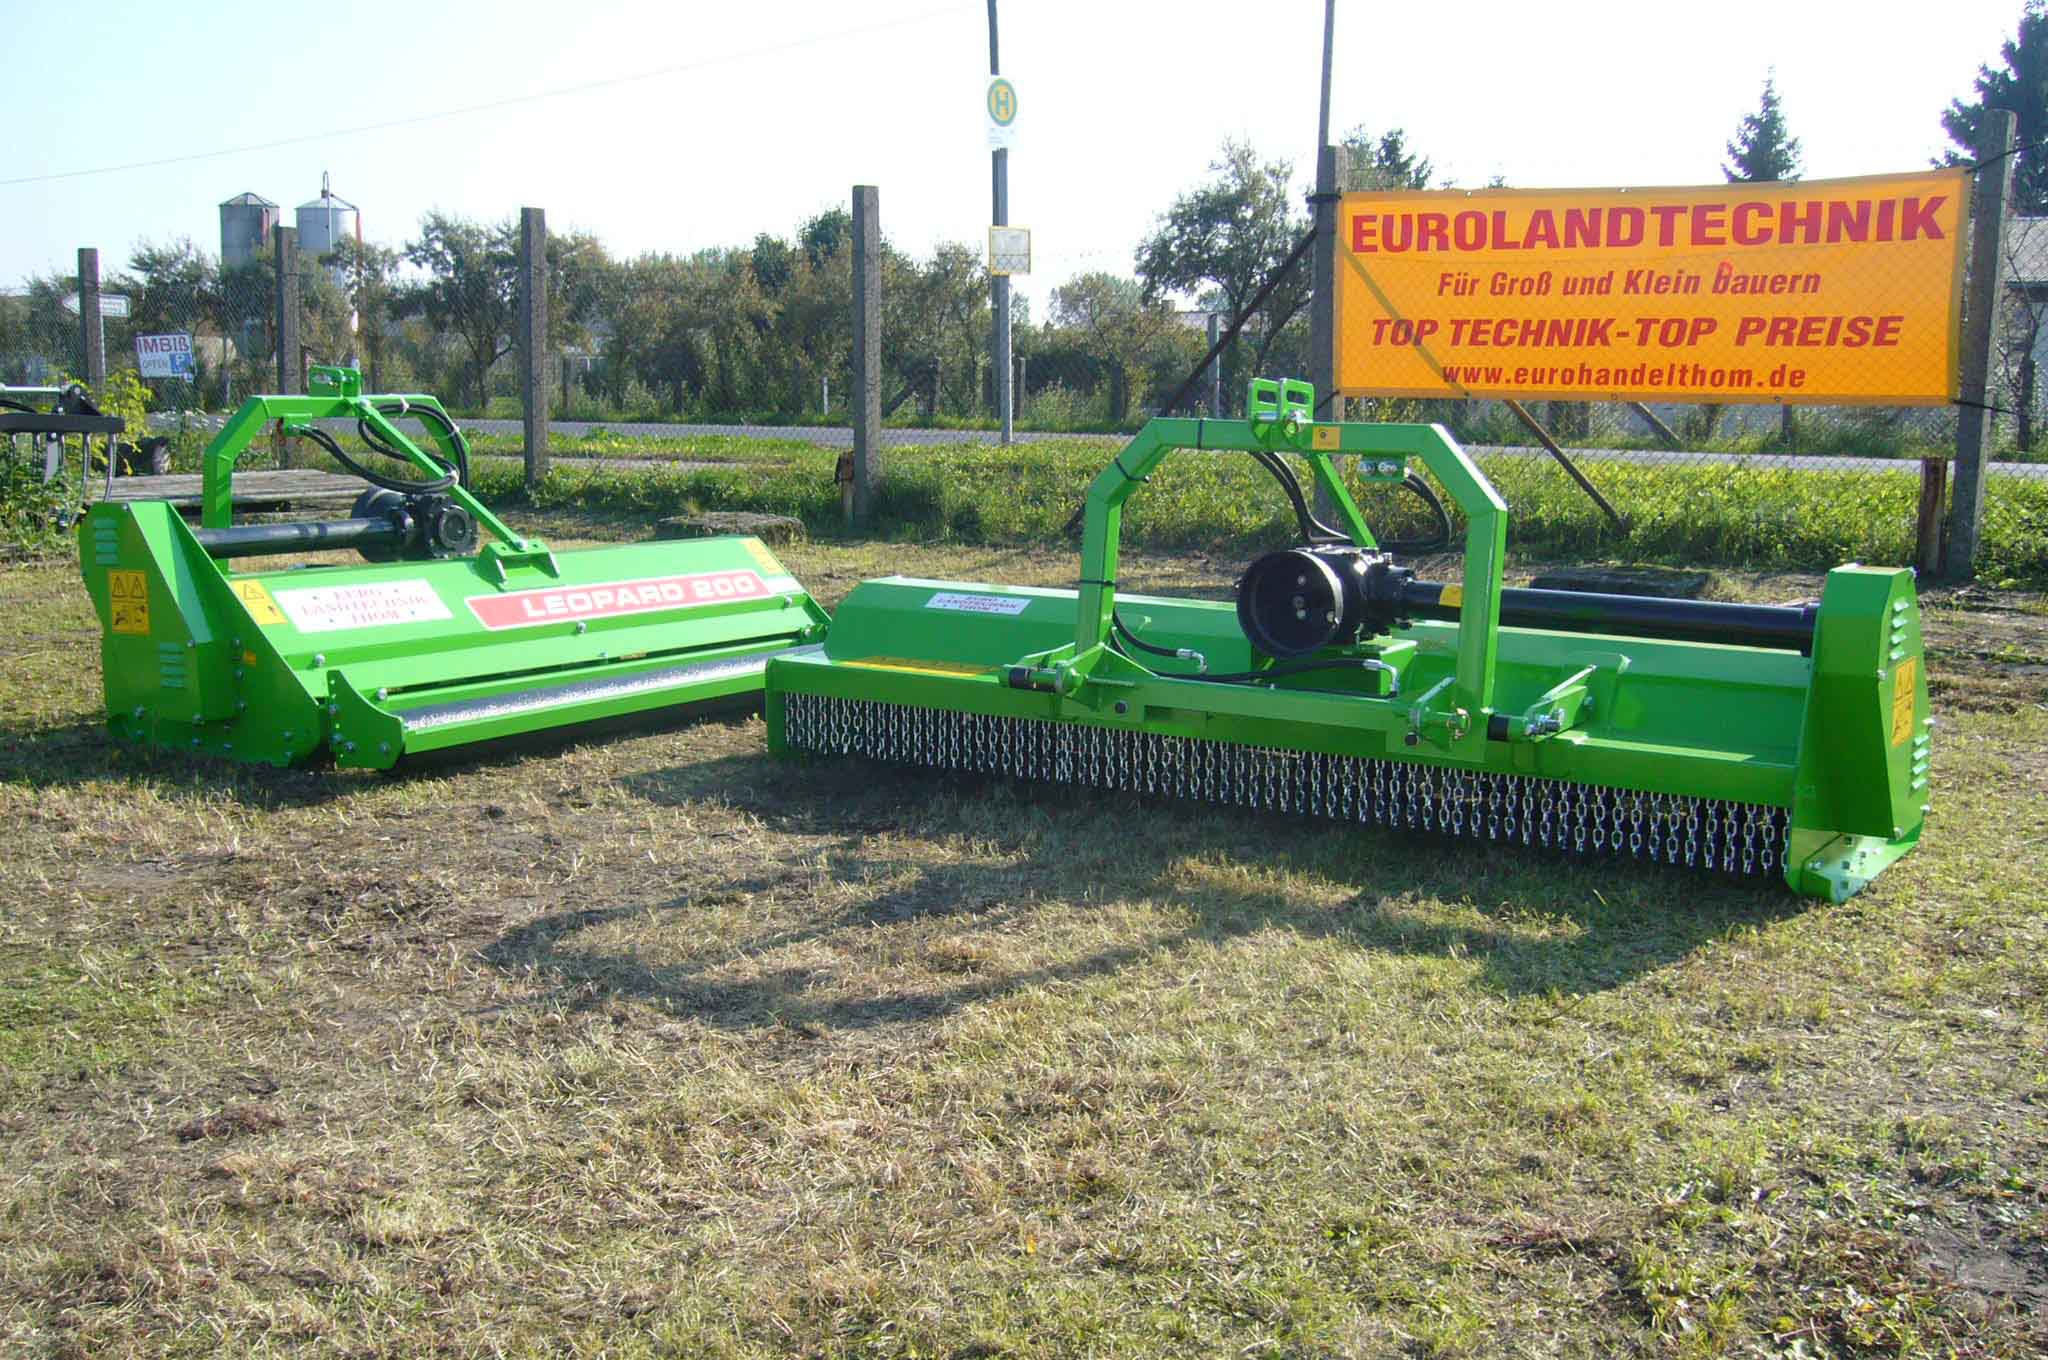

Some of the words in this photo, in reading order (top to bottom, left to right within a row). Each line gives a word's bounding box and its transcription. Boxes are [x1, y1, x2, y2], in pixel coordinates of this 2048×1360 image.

[1351, 196, 1949, 253] EUROLANDTECHNIK
[1437, 271, 1480, 296] Für
[1489, 271, 1552, 296] Groß
[1562, 269, 1614, 296] und
[1624, 268, 1702, 295] Klein
[1711, 261, 1822, 295] Bauern
[1372, 319, 1439, 347] TOP
[1449, 317, 1718, 348] TECHNIK-TOP
[1735, 315, 1905, 348] PREISE
[1441, 362, 1807, 388] www.eurohandelthom.de
[522, 582, 685, 618] LEOPARD
[693, 575, 757, 598] 200
